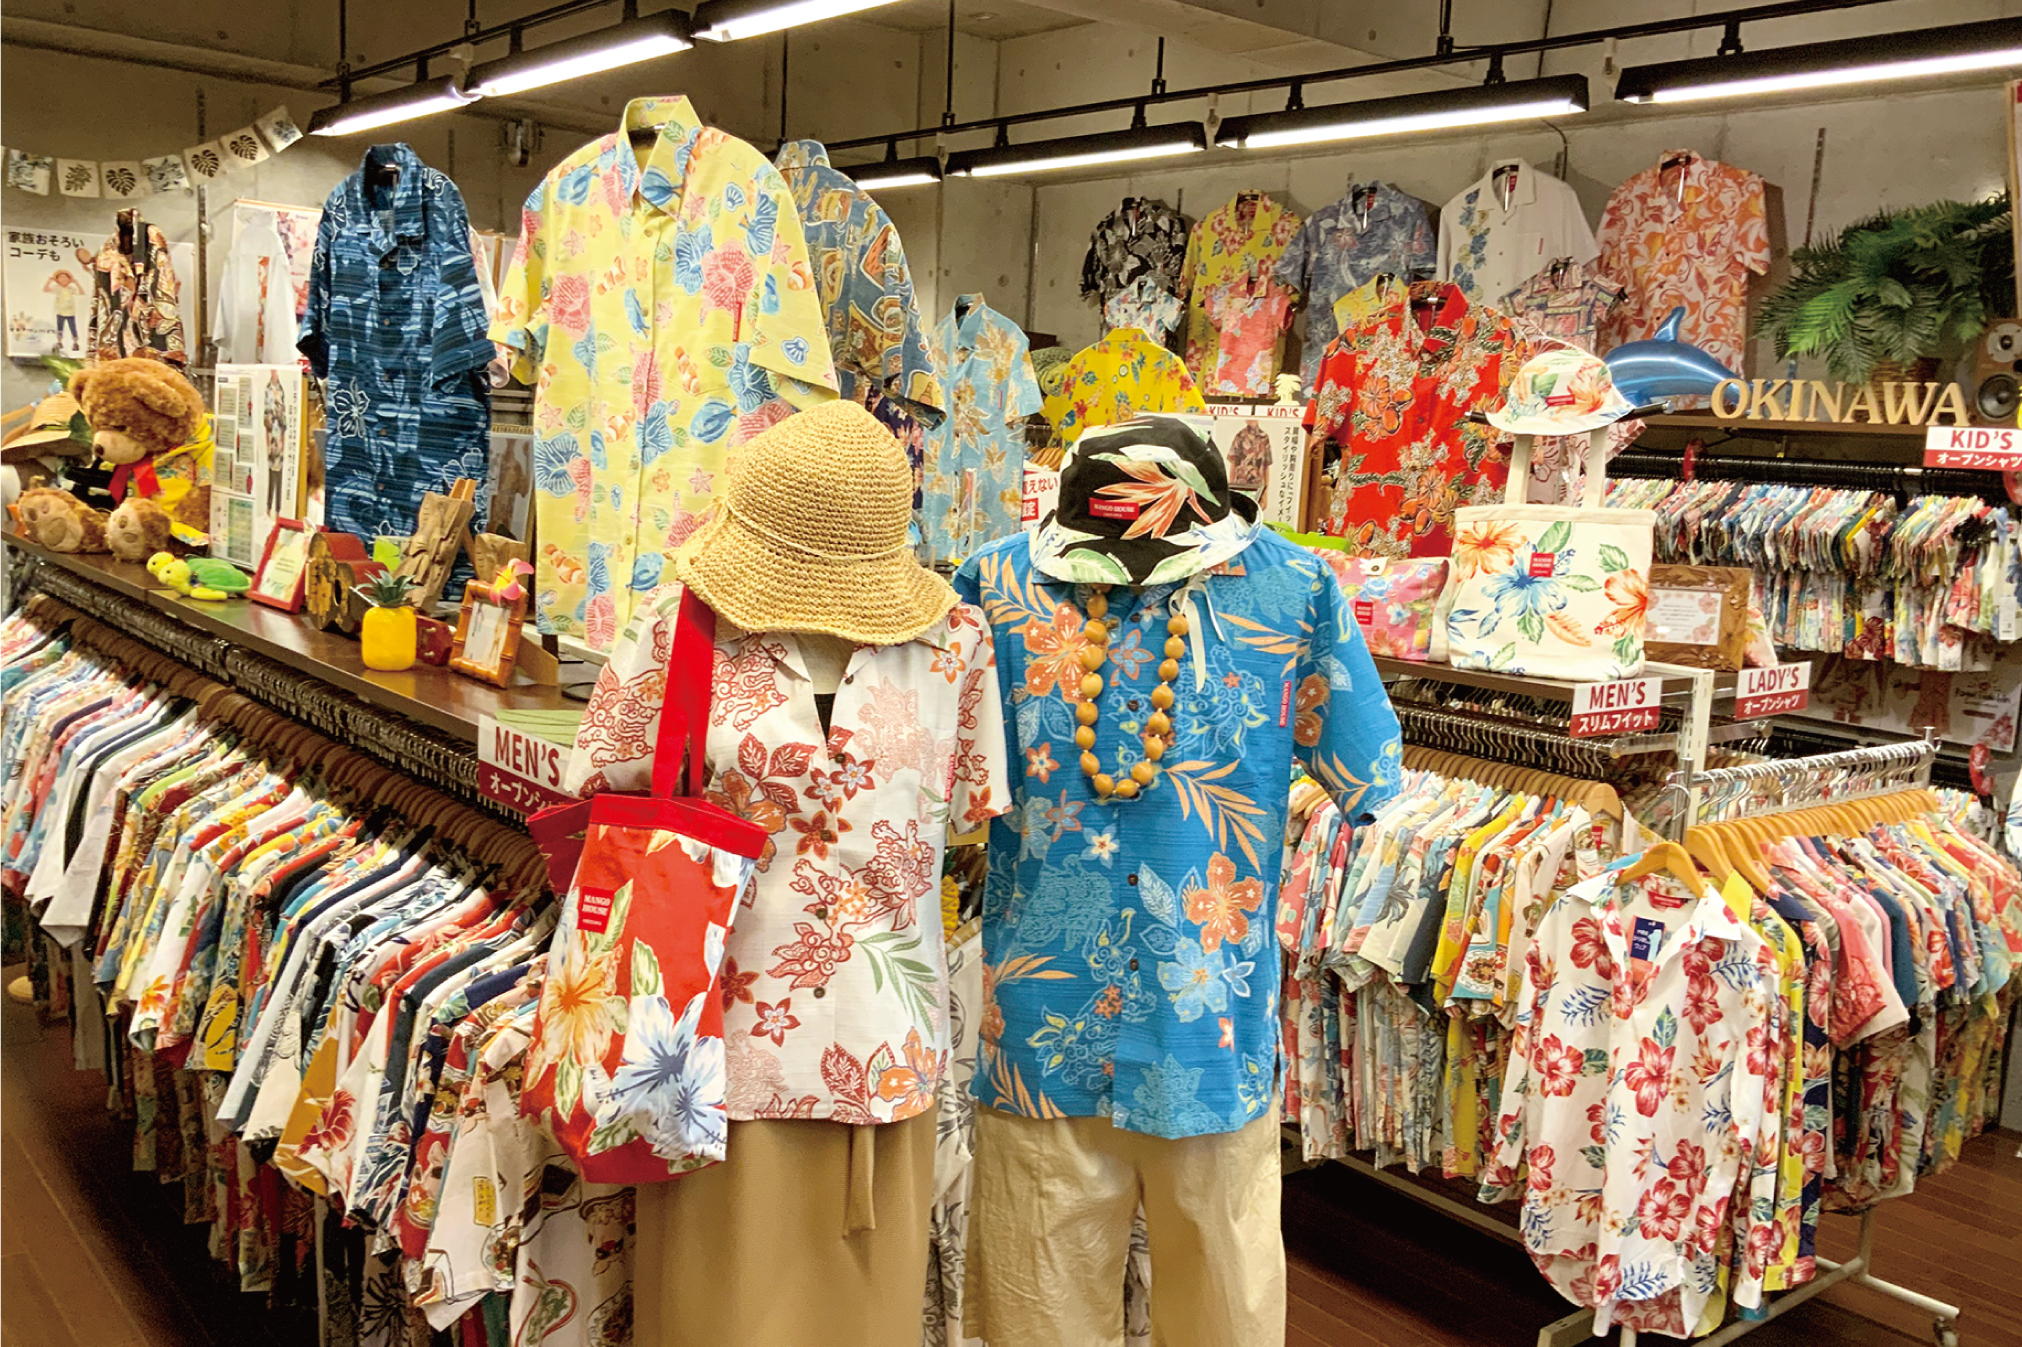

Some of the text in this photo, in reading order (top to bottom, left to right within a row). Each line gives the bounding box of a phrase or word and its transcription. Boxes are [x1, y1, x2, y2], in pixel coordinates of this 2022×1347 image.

[9, 246, 61, 262] コーデも
[1710, 378, 1971, 427] OKINAWA
[1949, 429, 2013, 451] KID'S
[1937, 452, 2022, 469] オープンシャツ
[1747, 666, 1800, 694] LADY'S
[1589, 681, 1646, 710] MEN'S
[1744, 694, 1801, 715] オープンシャツ
[494, 726, 560, 788] MEN'S
[582, 904, 609, 916] HOUSE
[583, 894, 611, 907] MANGO
